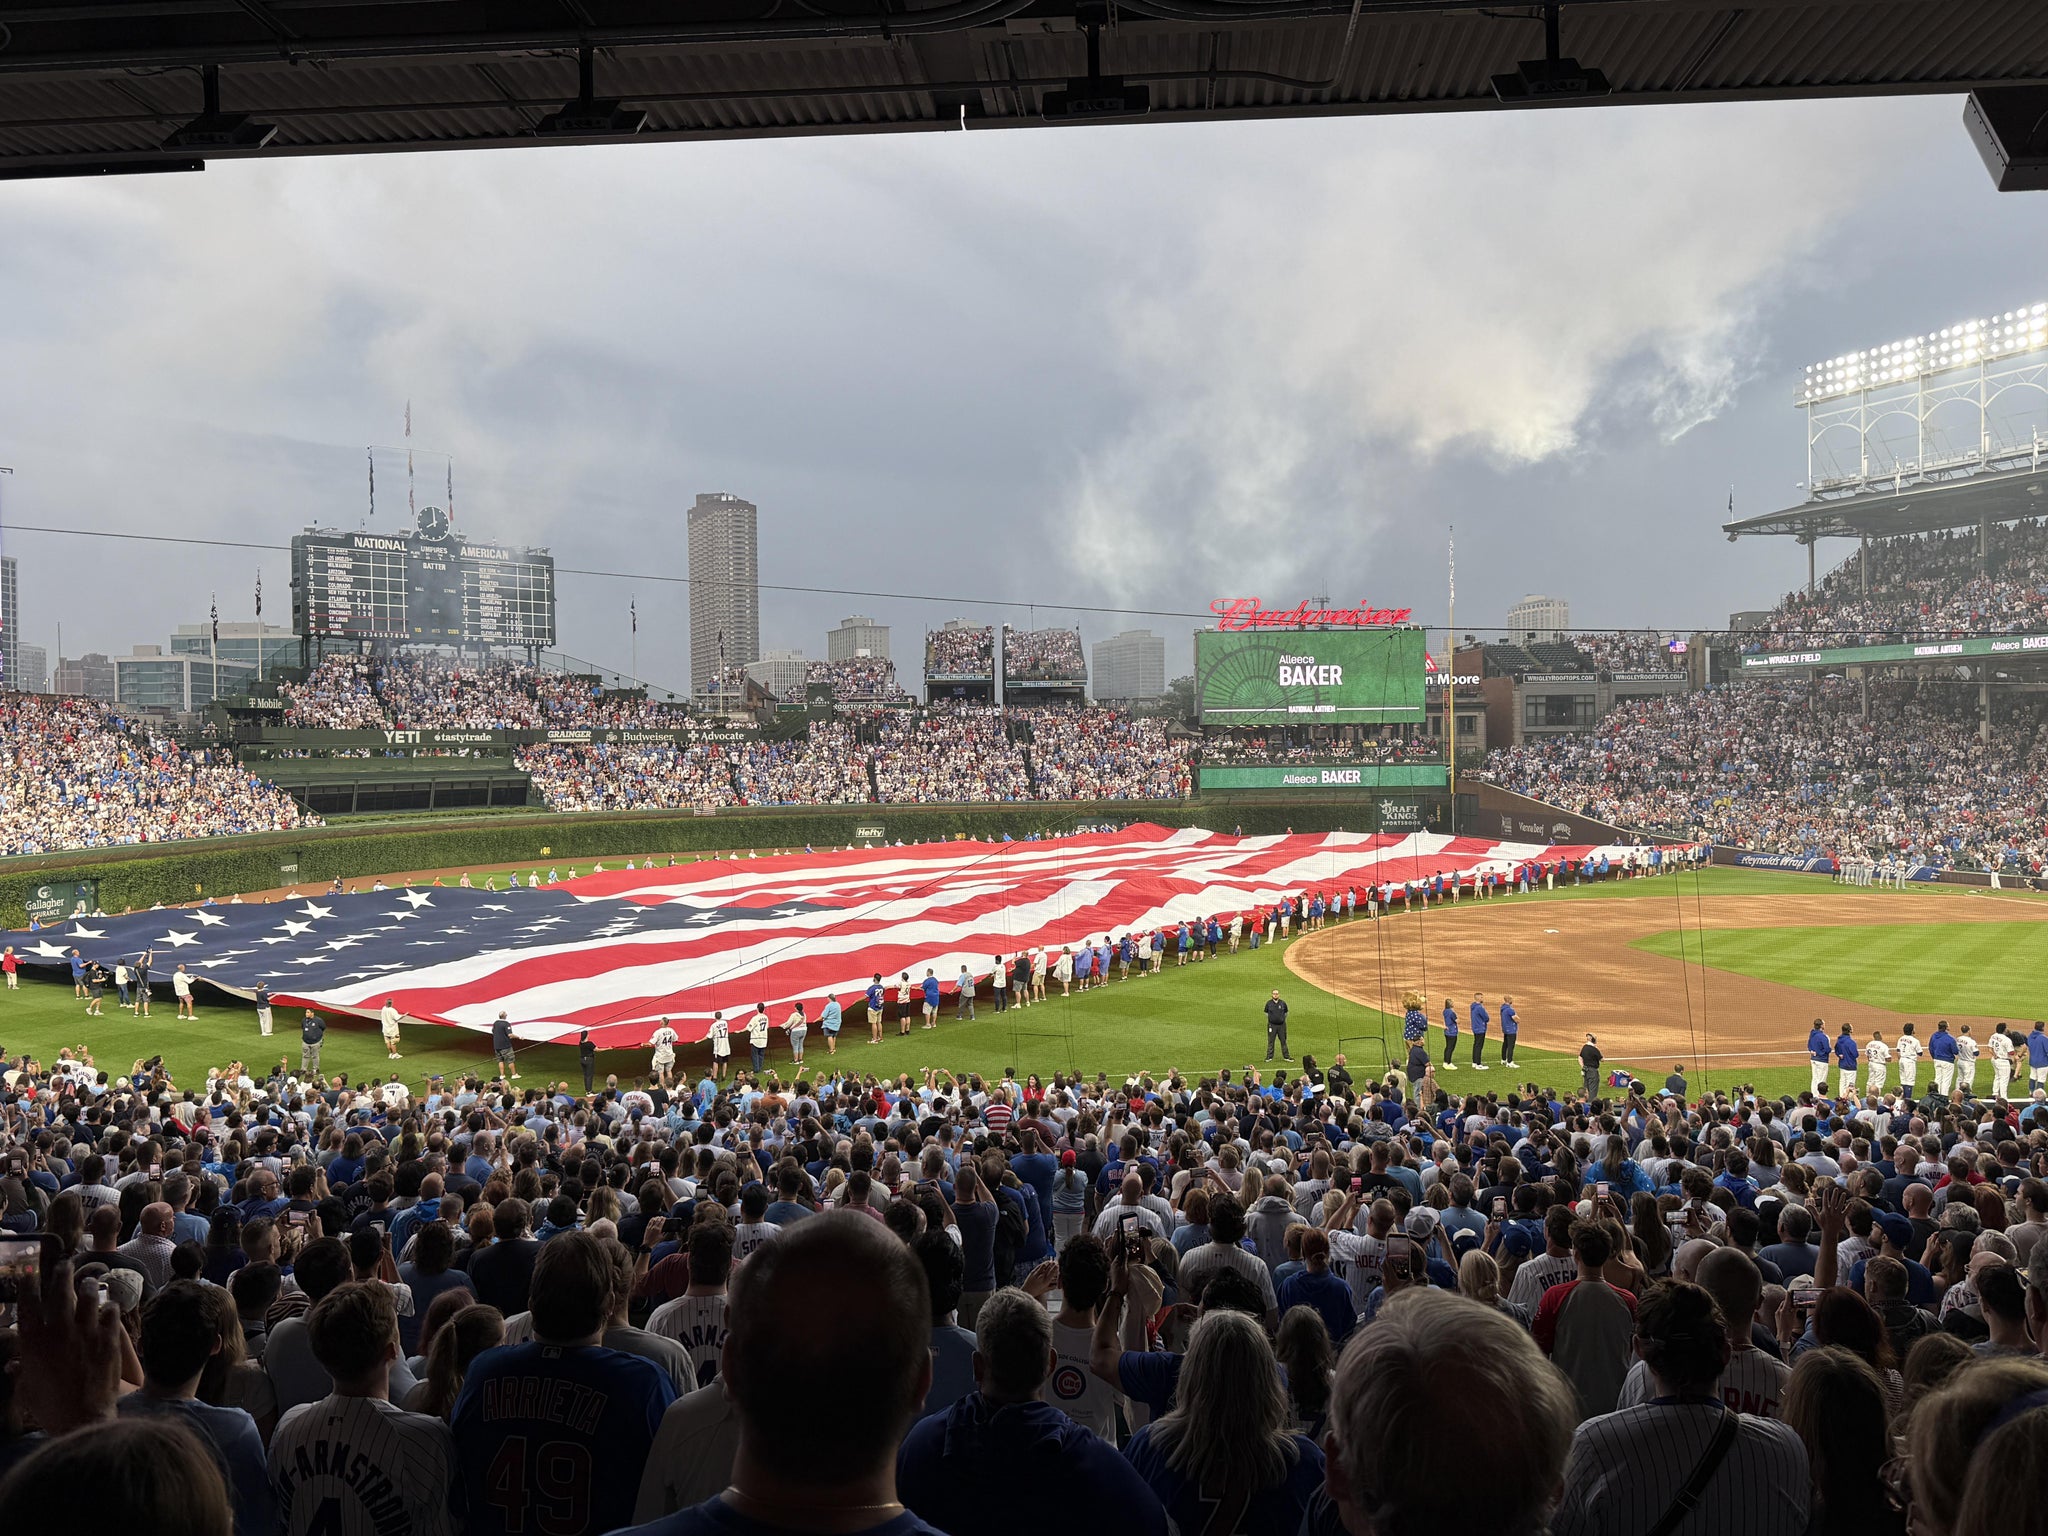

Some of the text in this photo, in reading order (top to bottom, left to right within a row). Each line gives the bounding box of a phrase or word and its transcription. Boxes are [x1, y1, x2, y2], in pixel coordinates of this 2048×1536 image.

[354, 537, 407, 552] NATIONAL
[420, 546, 448, 554] UMPIRES
[460, 546, 509, 560] AMERICAN
[422, 562, 446, 571] BATTER
[1209, 596, 1412, 632] Budweiser
[1991, 636, 2048, 650] Alleece BAKE
[1914, 644, 1962, 656] NATIONAL ANTHEM
[1279, 655, 1314, 664] Alleece
[1768, 654, 1800, 664] WRIGLEY
[1800, 653, 1821, 662] FIELD
[1279, 665, 1343, 686] BAKER
[1437, 674, 1480, 685] Moore
[257, 698, 282, 710] Mobile
[384, 730, 420, 744] YETI
[442, 732, 492, 744] tastytrade
[548, 730, 592, 738] GRAINGER
[623, 732, 674, 741] Budweiser
[701, 731, 744, 740] Advocate
[1283, 770, 1361, 784] Alleece BAKER
[1382, 806, 1419, 814] DRAFT
[858, 828, 883, 838] Hefty
[1742, 856, 1805, 869] Reynolds Wrap
[26, 898, 64, 910] Gallagher
[718, 1028, 728, 1038] 17
[760, 1022, 766, 1032] 17
[662, 1036, 672, 1046] 44
[482, 1376, 608, 1436] ARRIETA
[487, 1434, 592, 1536] 49
